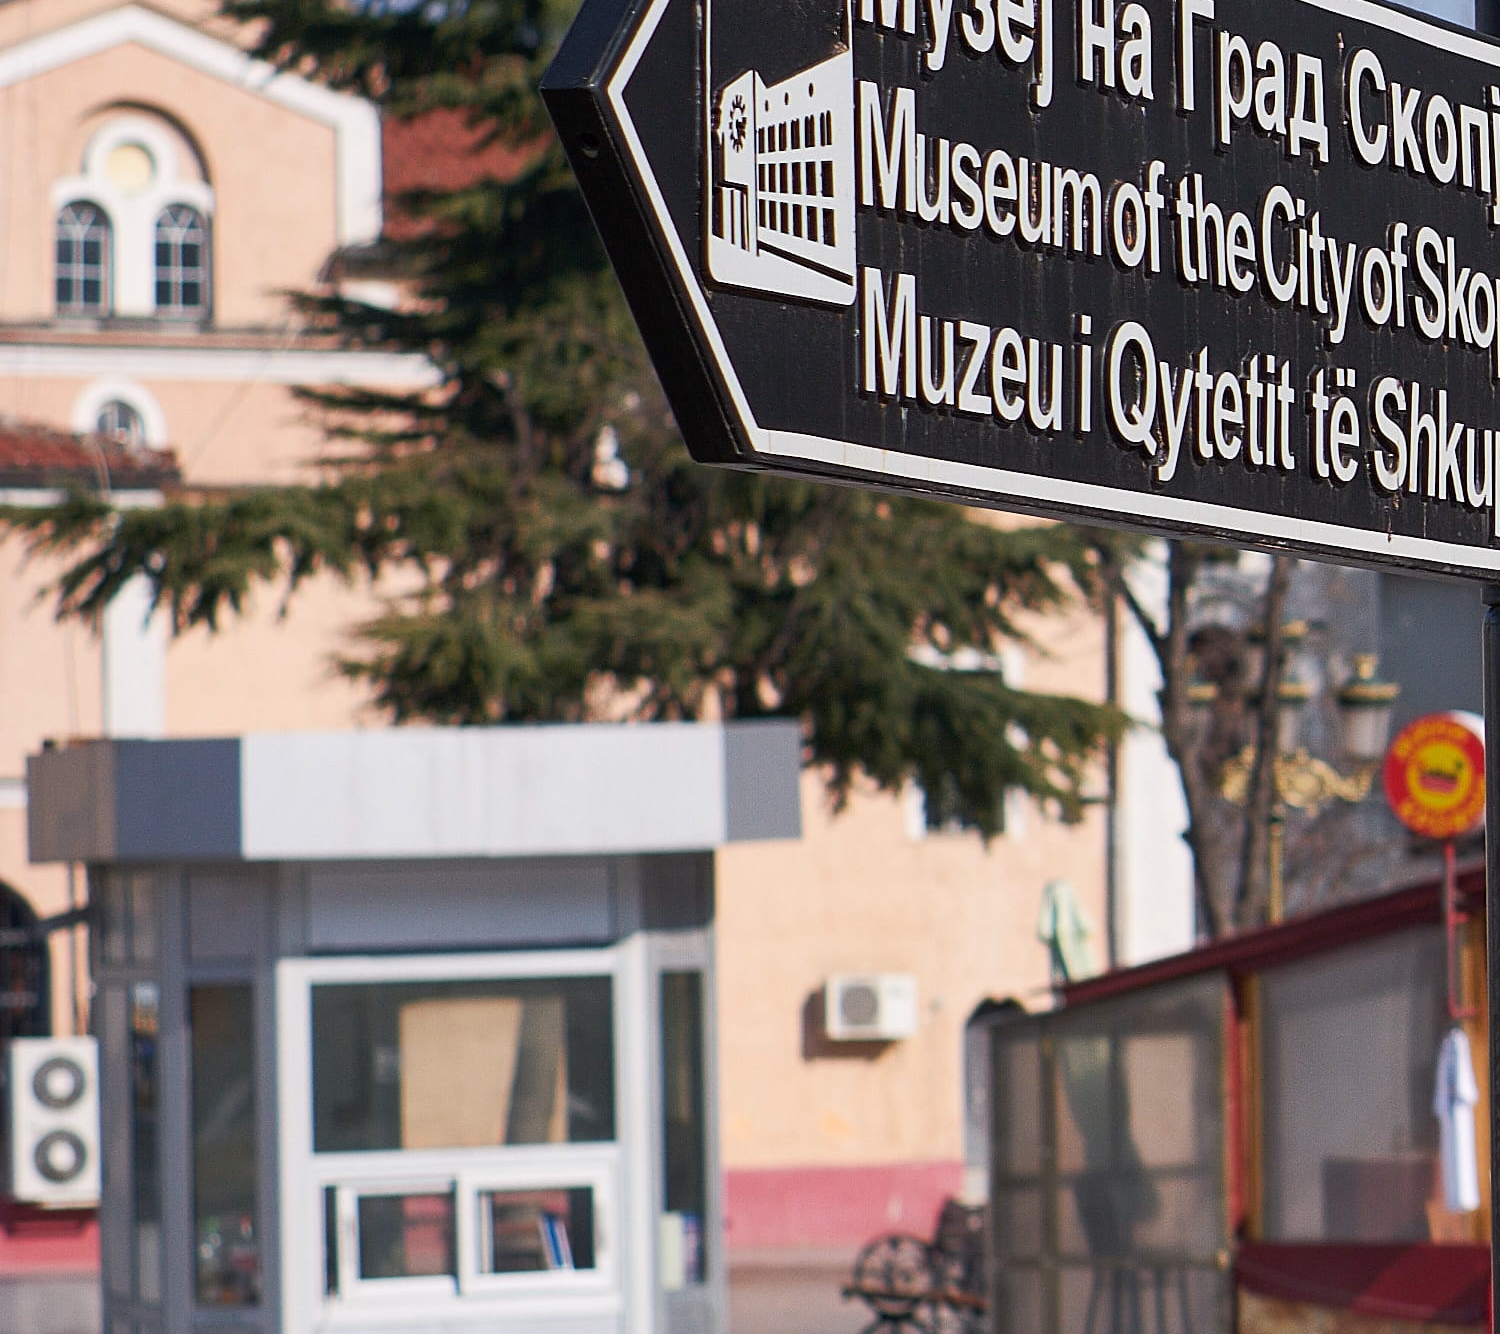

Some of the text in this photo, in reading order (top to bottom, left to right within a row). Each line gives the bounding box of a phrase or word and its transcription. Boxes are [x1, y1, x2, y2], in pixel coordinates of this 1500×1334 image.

[860, 80, 1102, 257] Museum
[1114, 160, 1163, 272] of
[1175, 173, 1255, 295] the
[1262, 186, 1354, 344] City
[1362, 222, 1407, 328] of
[863, 266, 1063, 431] Muzeu
[1080, 315, 1091, 433] i
[1109, 321, 1295, 482] Qytetit
[1312, 365, 1360, 482] të
